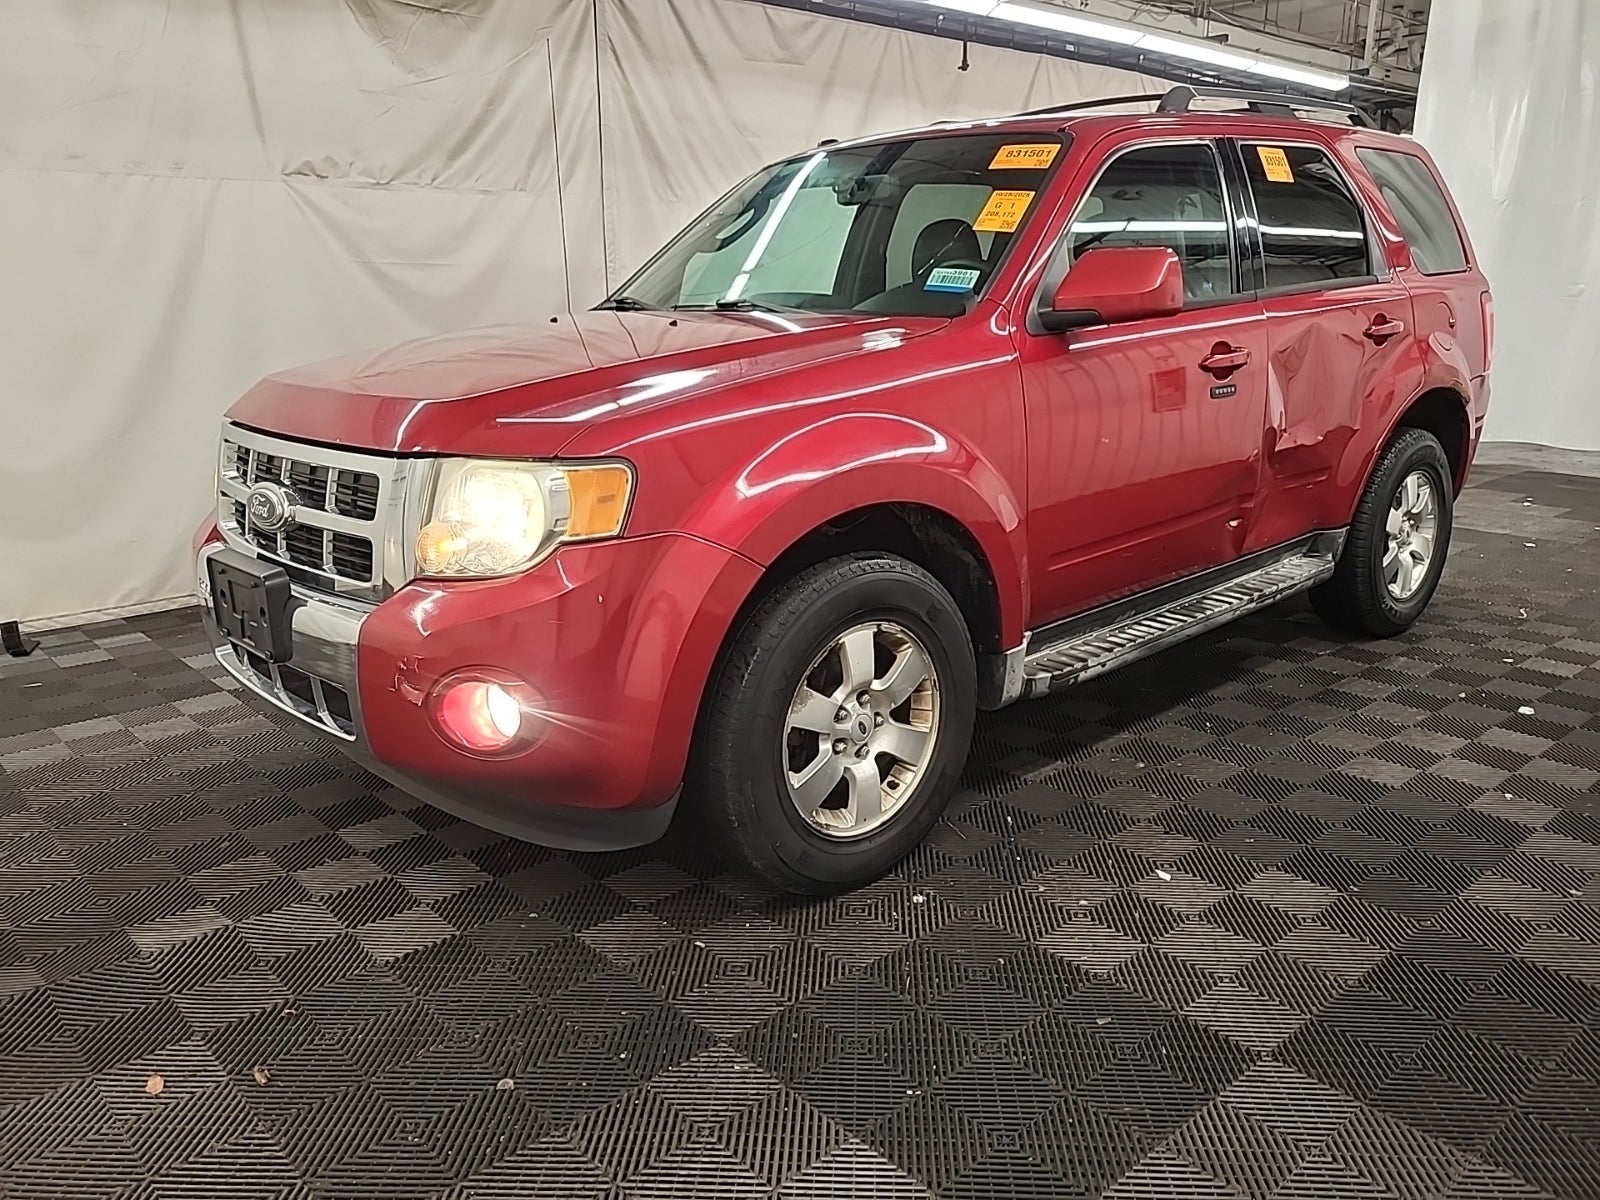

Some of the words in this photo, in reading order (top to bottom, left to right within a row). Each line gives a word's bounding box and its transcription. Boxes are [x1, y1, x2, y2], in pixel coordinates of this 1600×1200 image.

[1005, 149, 1053, 158] 831501
[1264, 154, 1287, 167] 831501
[994, 201, 1003, 209] G
[250, 494, 270, 518] Ford
